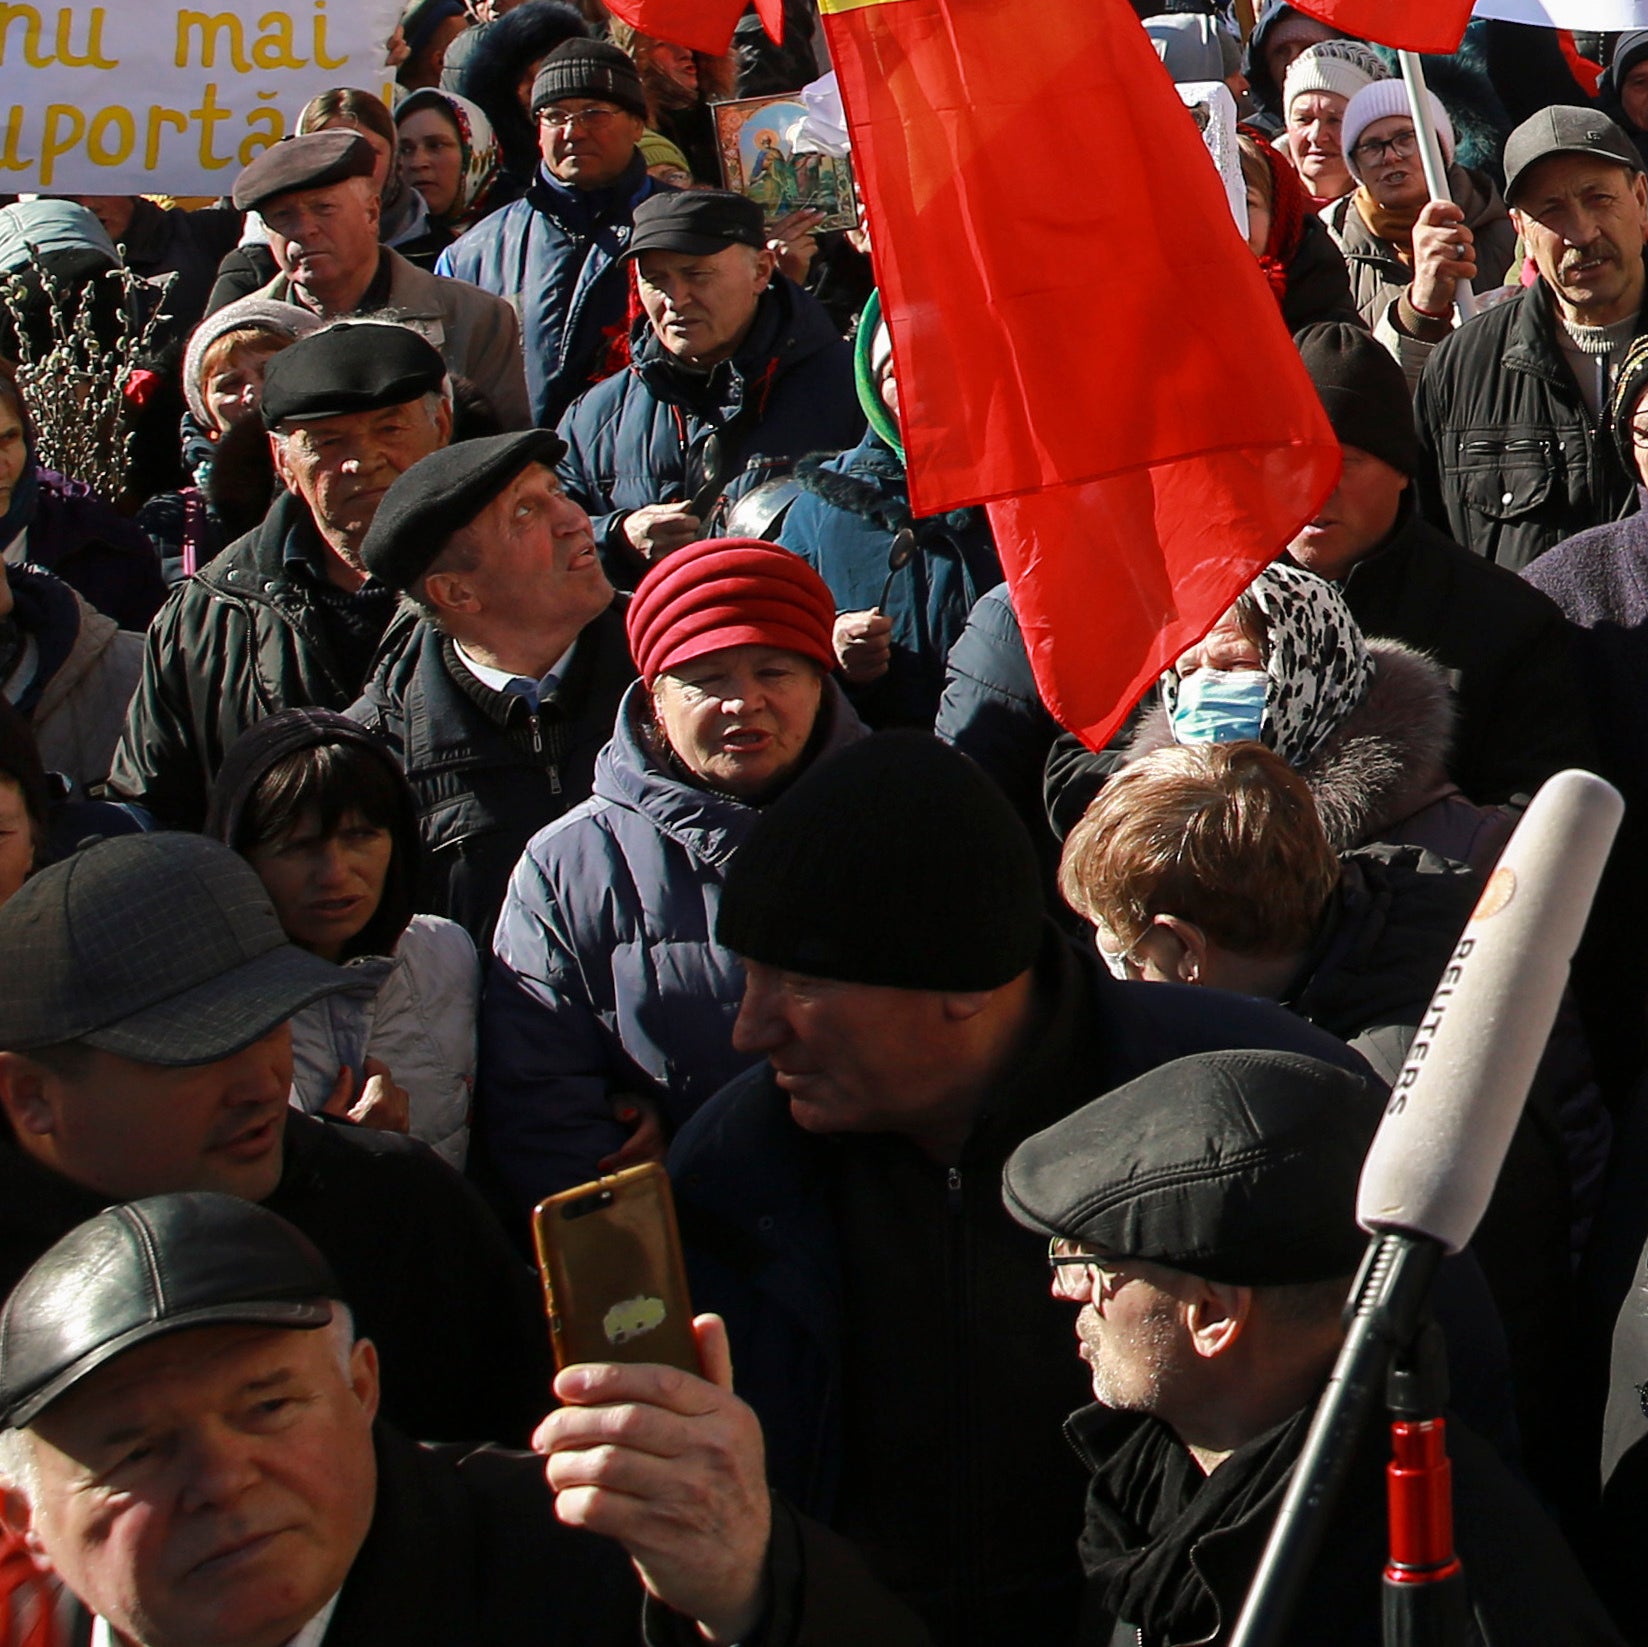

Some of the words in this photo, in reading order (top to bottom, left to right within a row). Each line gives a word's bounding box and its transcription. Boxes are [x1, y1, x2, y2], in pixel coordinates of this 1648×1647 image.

[0, 3, 118, 69] nu
[175, 0, 349, 74] mai
[1387, 936, 1477, 1117] REUTERS
